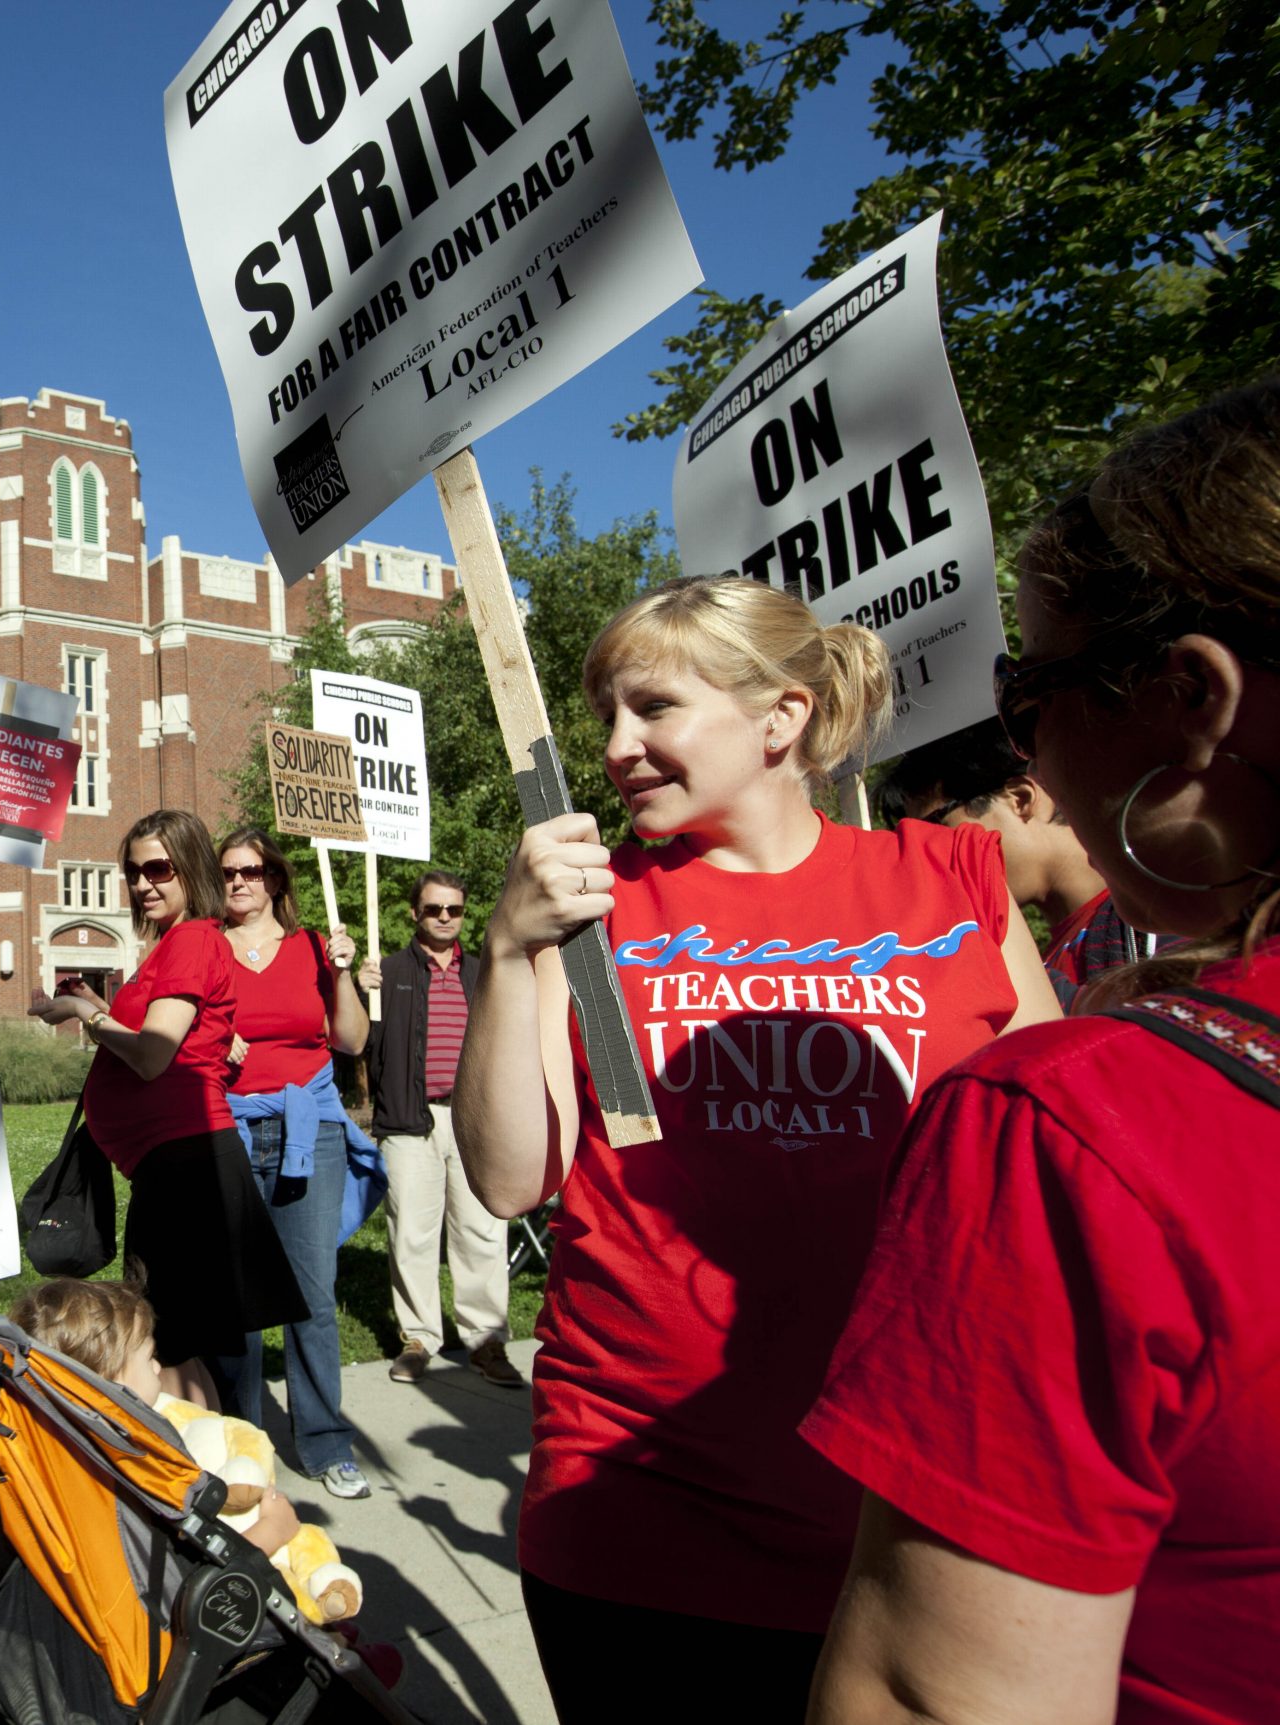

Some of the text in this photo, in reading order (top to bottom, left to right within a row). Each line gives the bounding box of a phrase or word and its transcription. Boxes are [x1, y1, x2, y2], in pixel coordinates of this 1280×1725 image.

[194, 2, 277, 112] CHICAGO
[282, 0, 414, 145] ON
[234, 0, 575, 357] STRIKE
[268, 115, 595, 425] FOR A FAIR CONTRACT
[371, 196, 619, 396] American Federation of Teachers
[416, 264, 577, 404] Local 1
[467, 336, 544, 400] AFL-CIO
[693, 268, 898, 452] CHICAGO PUBLIC SCHOOLS
[750, 377, 844, 508] ON
[286, 453, 339, 506] TEACHERS
[291, 470, 346, 526] UNION
[720, 437, 953, 603] TRIKE
[901, 619, 967, 658] of Teachers
[915, 655, 933, 687] 1
[272, 730, 351, 780] SOLIDARITY
[354, 712, 388, 748] ON
[0, 775, 25, 788] BELLAS
[354, 756, 418, 796] RIKE
[275, 781, 361, 825] FOREVER!
[359, 798, 419, 816] AIR CONTRACT
[372, 826, 399, 840] Local
[80, 932, 86, 941] 2
[643, 971, 926, 1018] TEACHERS
[644, 1018, 926, 1105] UNION
[704, 1100, 875, 1140] LOCAL 1
[206, 1589, 243, 1632] City
